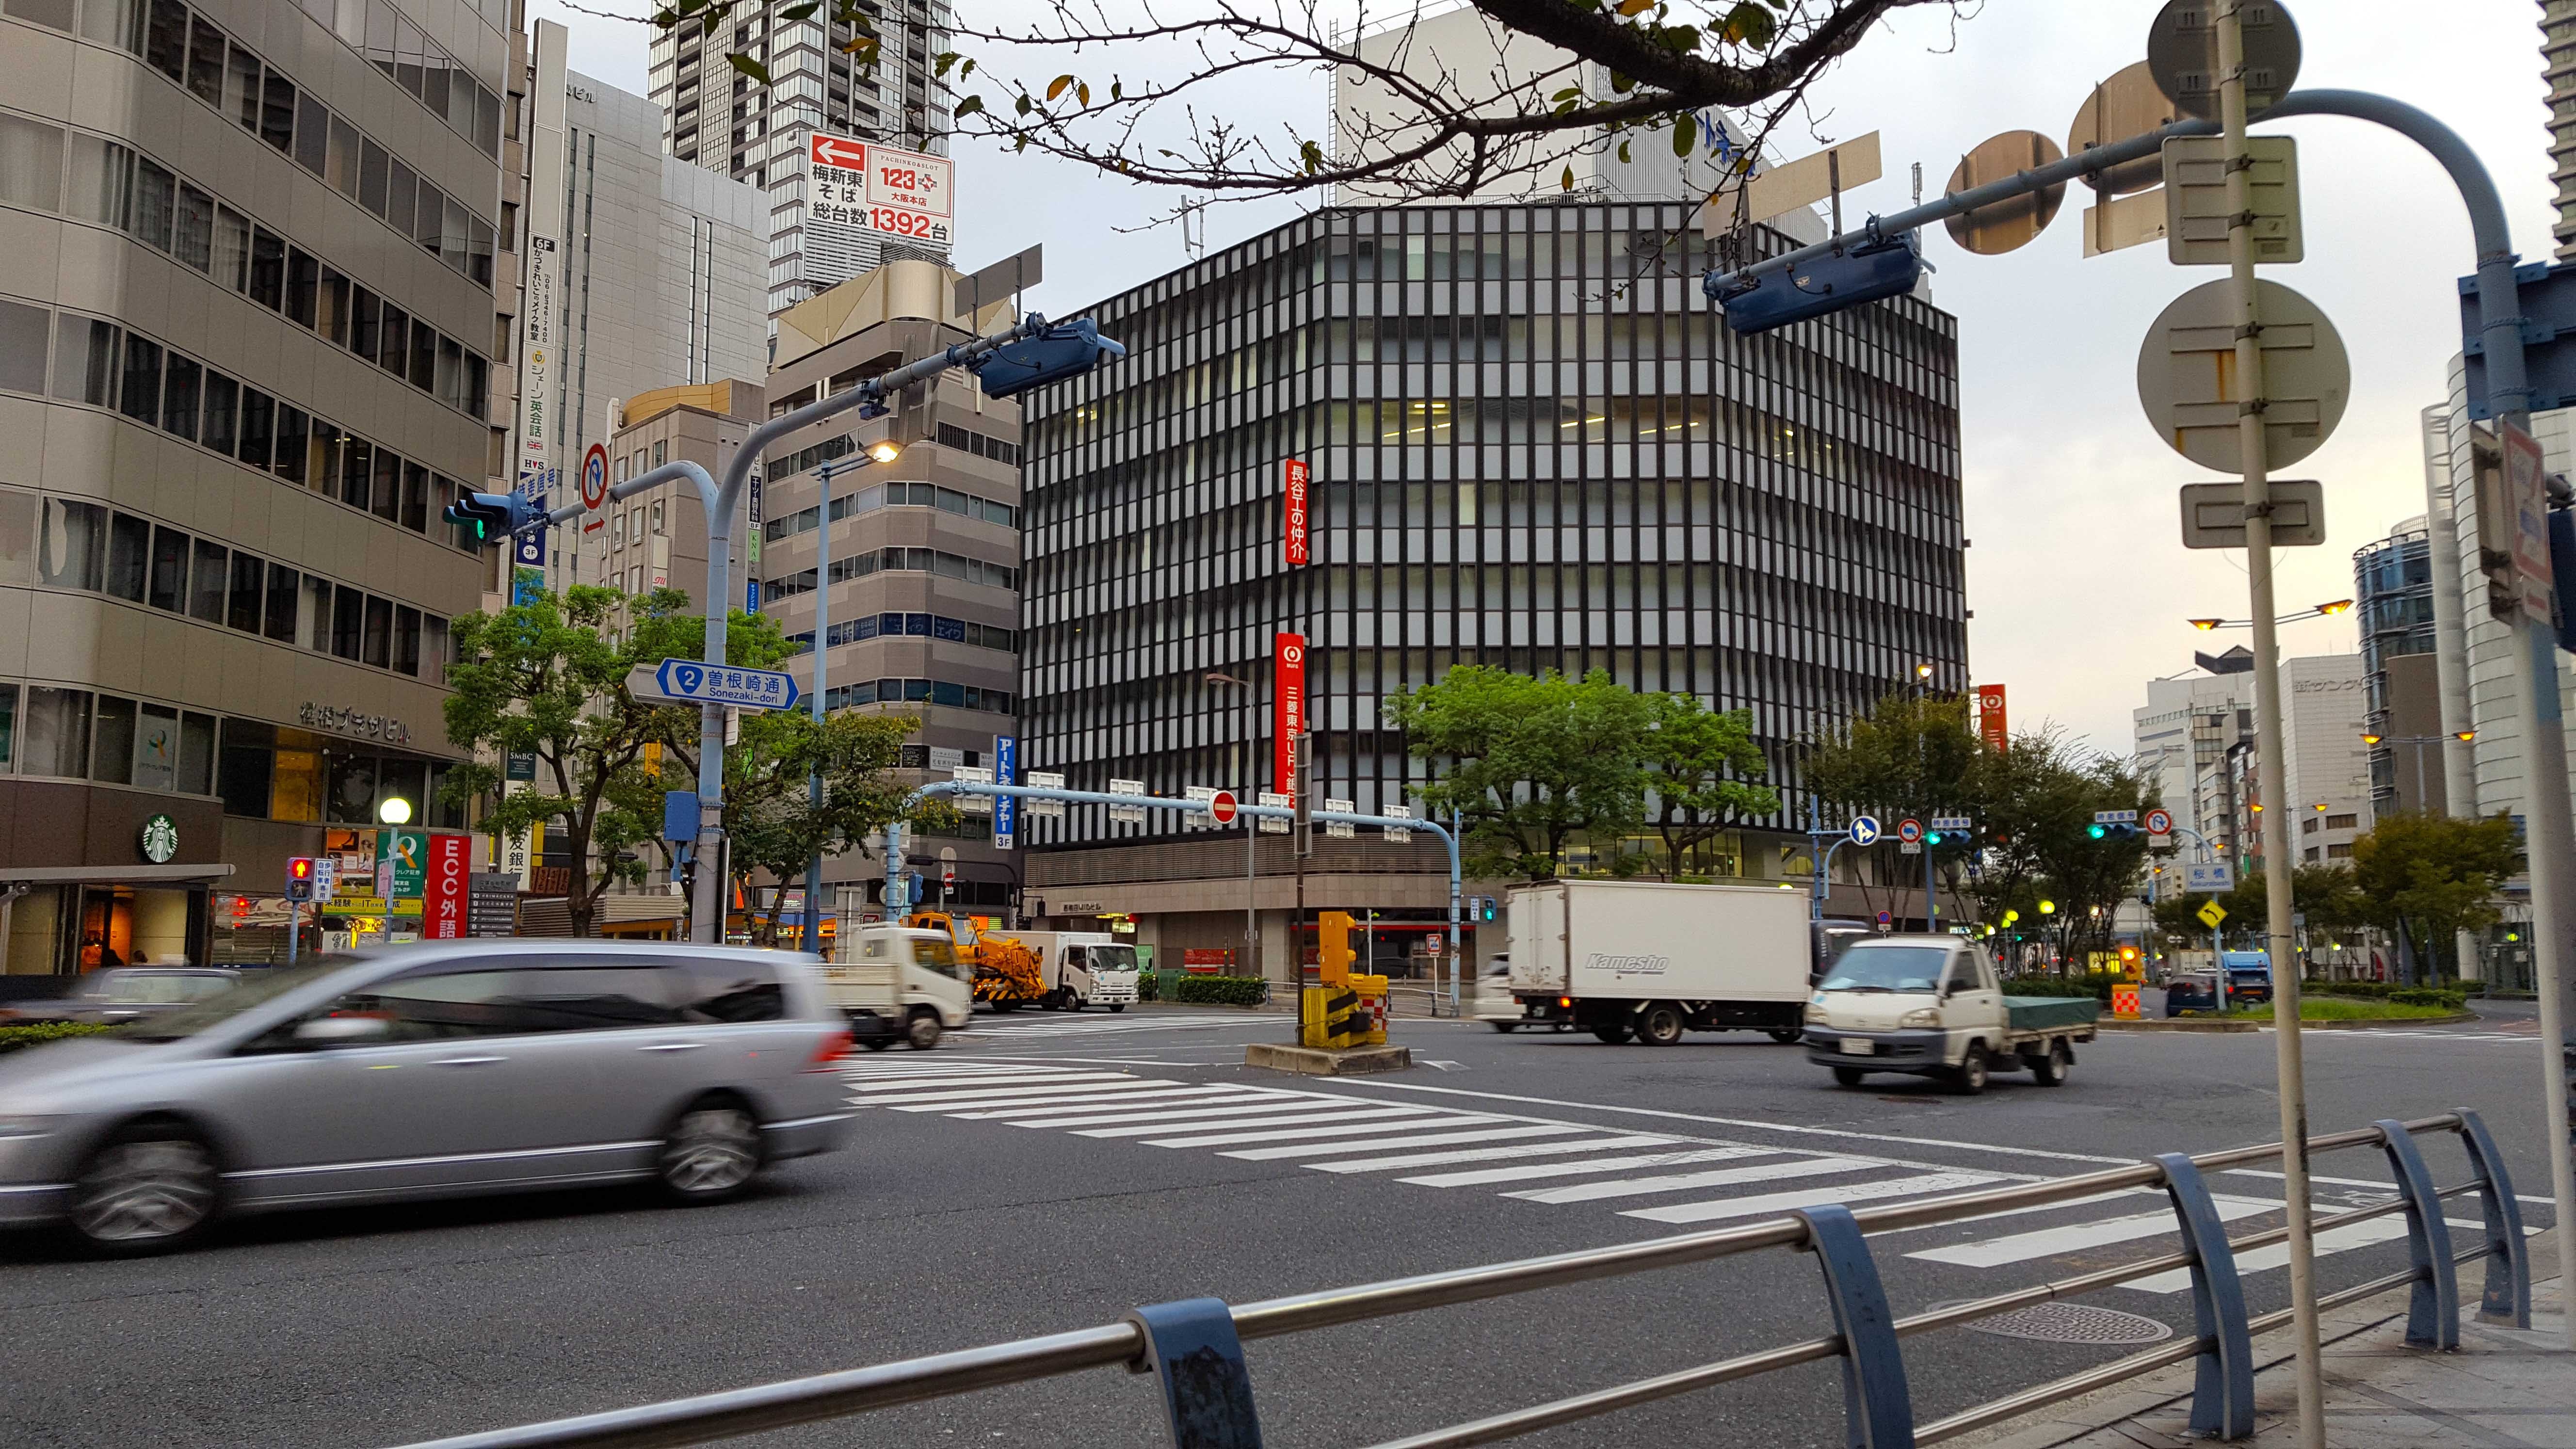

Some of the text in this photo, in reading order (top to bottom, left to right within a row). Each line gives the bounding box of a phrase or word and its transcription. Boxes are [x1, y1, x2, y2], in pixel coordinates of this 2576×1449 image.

[880, 155, 939, 171] PACHINKO&SLOT
[812, 164, 864, 189] 梅新東
[880, 167, 916, 191] 123
[818, 183, 857, 204] そば
[891, 192, 928, 207] 大阪本店
[536, 239, 550, 250] 6F
[529, 365, 545, 438] シェーン英会話
[1290, 465, 1305, 560] 長谷工の仲介
[935, 626, 962, 640] エイワ
[684, 670, 695, 687] 2
[708, 670, 780, 694] 曽根崎通
[709, 687, 778, 704] Sonezaki-dori
[510, 752, 533, 760] SMBC
[998, 738, 1012, 832] アートネチャー
[998, 837, 1010, 847] 3F
[439, 839, 459, 938] ECC外語
[1585, 952, 1669, 970] Kamesho
